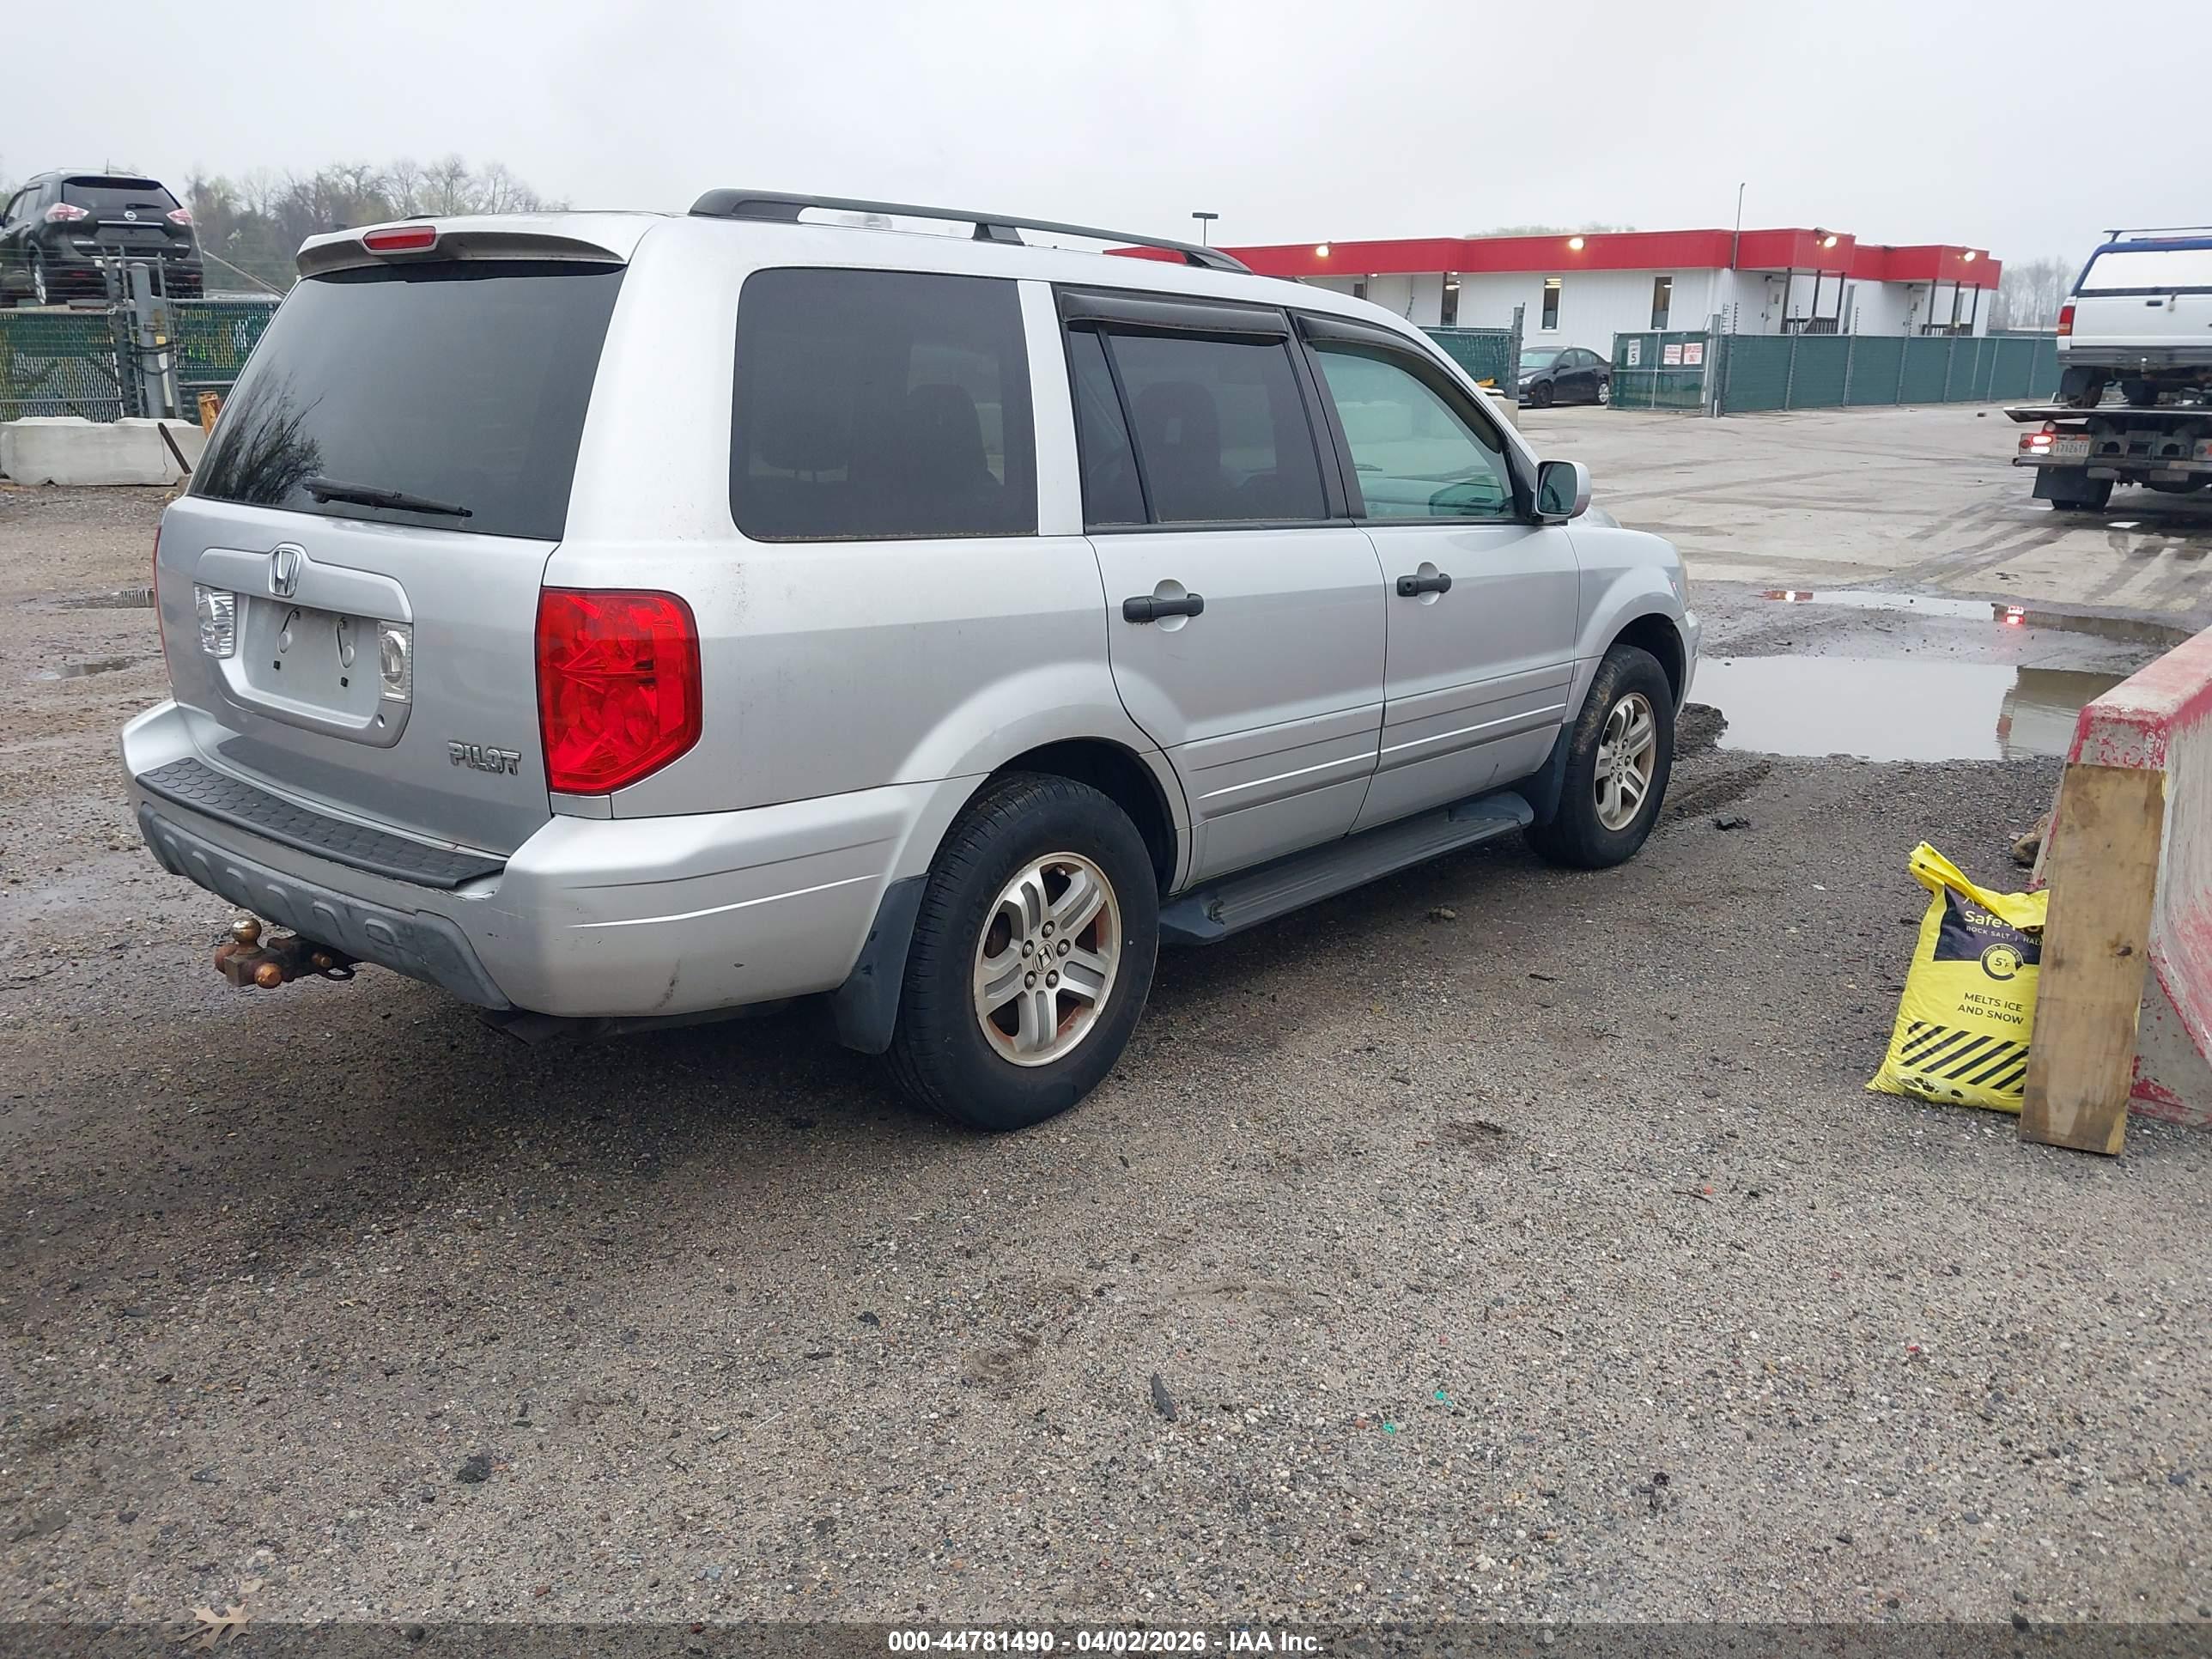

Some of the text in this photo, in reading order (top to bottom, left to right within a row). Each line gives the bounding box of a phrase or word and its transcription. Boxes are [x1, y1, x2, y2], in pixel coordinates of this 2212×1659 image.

[1631, 353, 1637, 363] 5
[447, 740, 521, 775] PILOT
[1990, 931, 2010, 940] SALT
[1964, 992, 2024, 1012] MELTS ICE
[1957, 1004, 2024, 1024] AND SNOW
